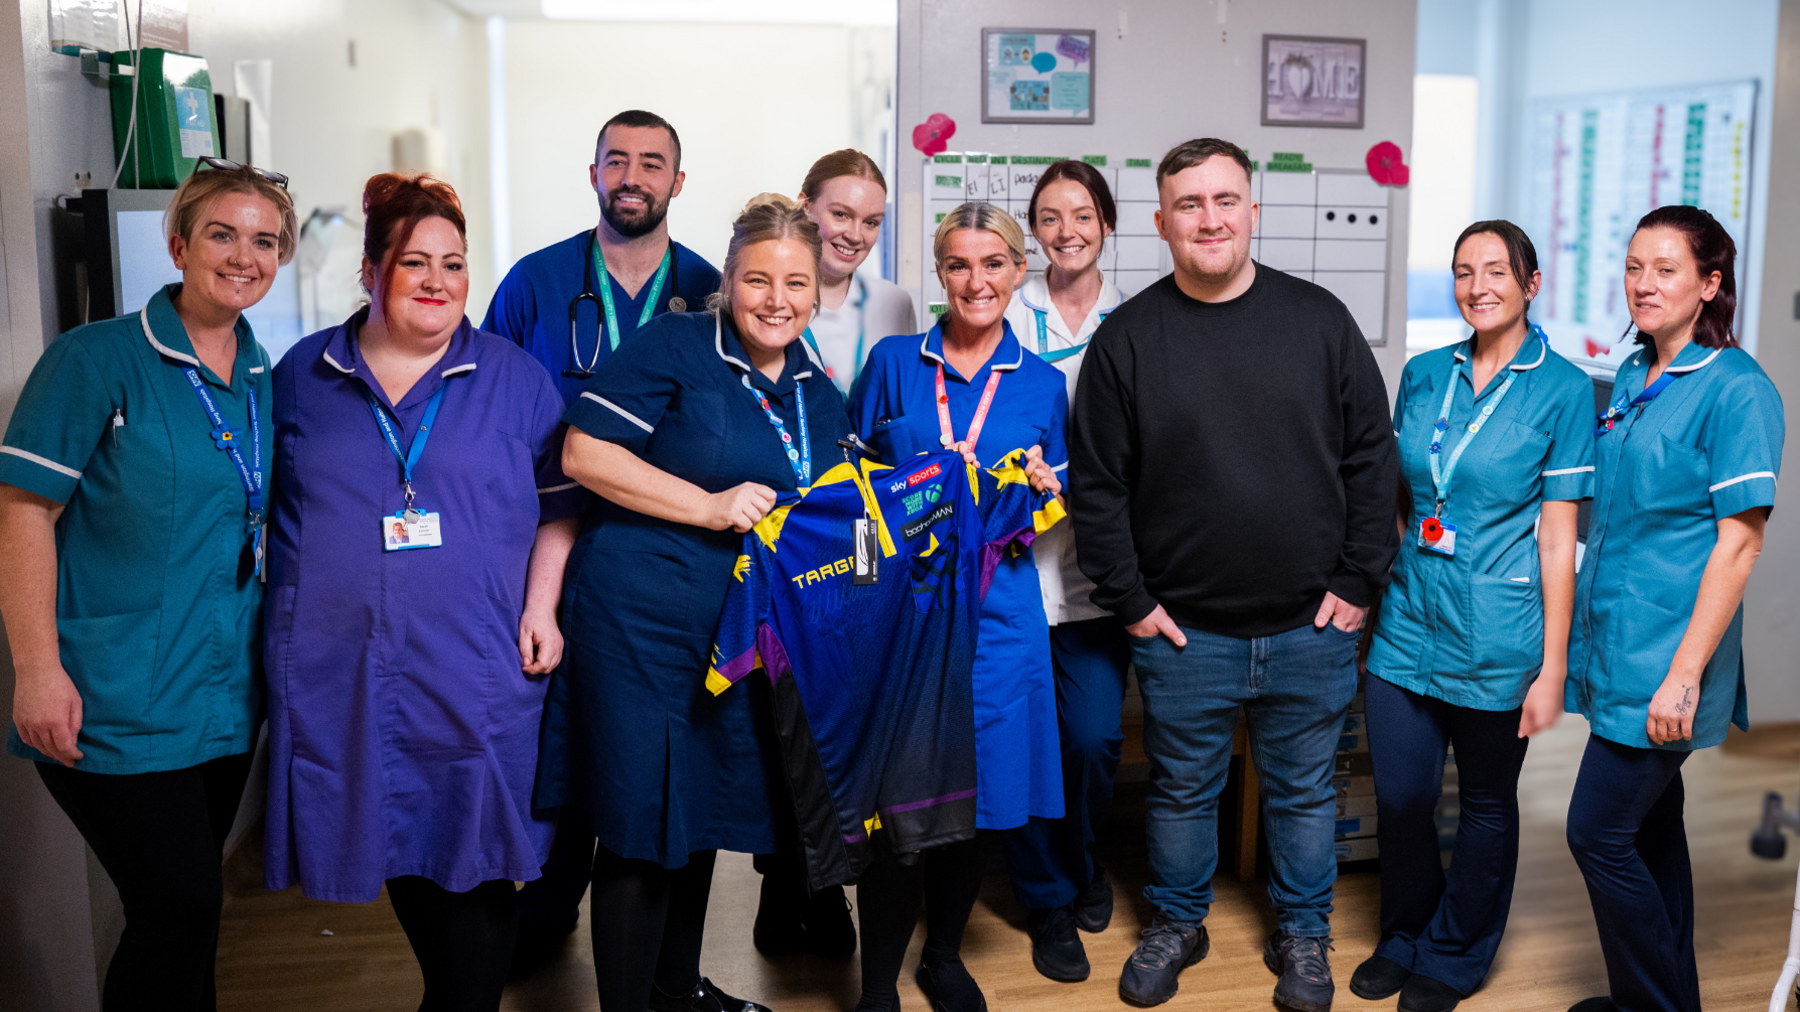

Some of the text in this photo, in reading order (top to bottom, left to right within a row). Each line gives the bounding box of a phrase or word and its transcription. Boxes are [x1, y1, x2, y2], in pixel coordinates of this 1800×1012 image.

[934, 155, 962, 163] CYCLE
[1084, 156, 1105, 165] DATE
[1267, 162, 1312, 172] BREAKFAST
[658, 267, 666, 280] Doctor
[642, 308, 650, 323] Doctor
[187, 370, 202, 387] NHS
[199, 388, 217, 413] Hospitals
[982, 391, 992, 405] NURSE
[973, 410, 984, 429] CHARGE
[383, 423, 391, 432] and
[235, 453, 243, 463] and
[802, 461, 810, 478] NHS
[253, 471, 262, 488] NHS
[890, 465, 940, 493] sky sports
[905, 505, 953, 537] boohooMAN
